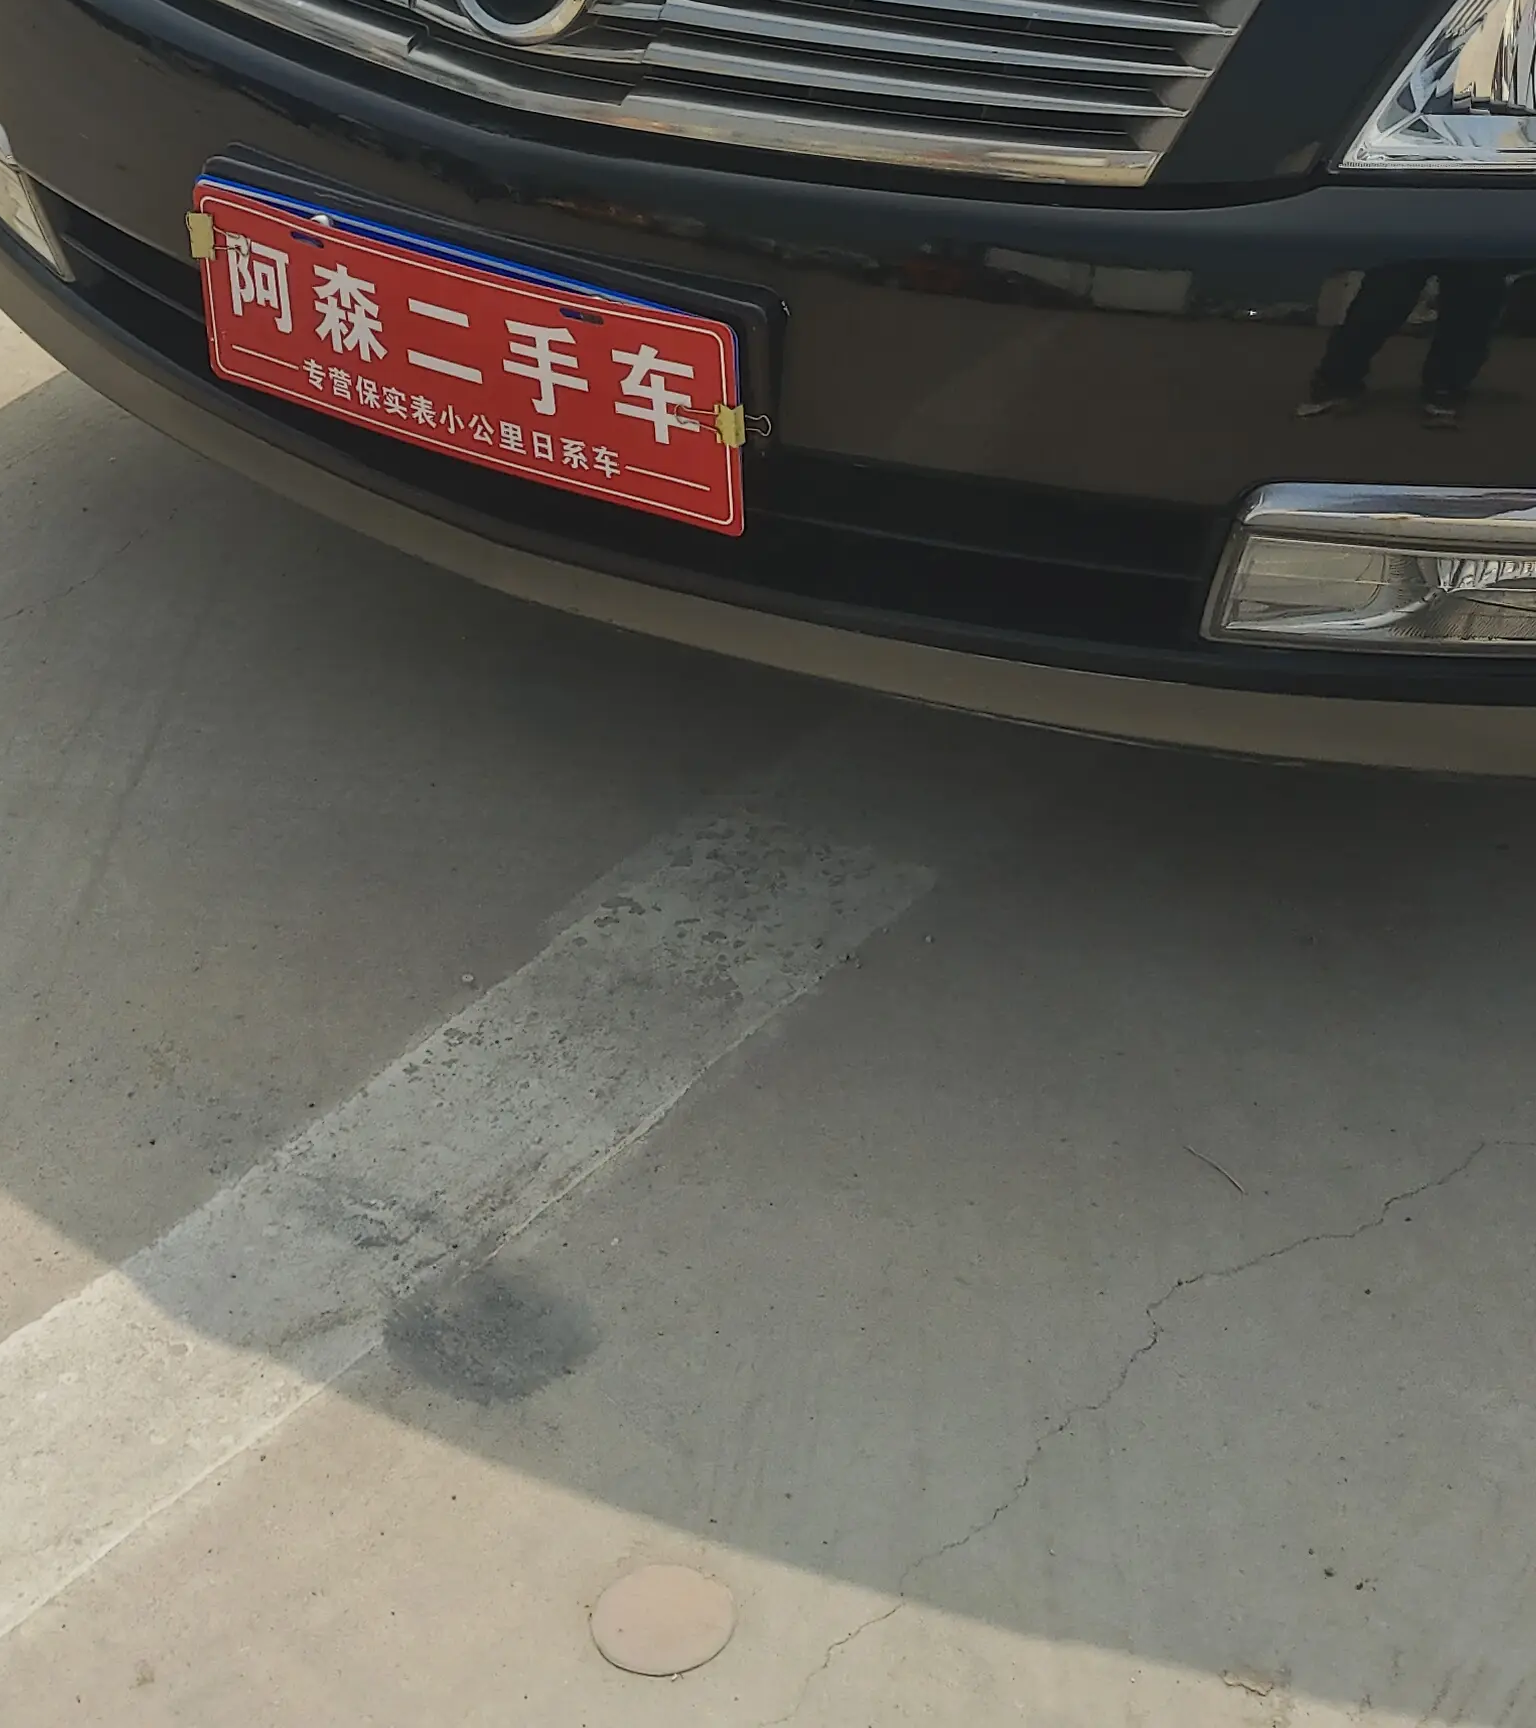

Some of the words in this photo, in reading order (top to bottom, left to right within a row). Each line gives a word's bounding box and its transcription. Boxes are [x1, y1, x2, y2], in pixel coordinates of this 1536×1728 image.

[227, 233, 701, 445] 阿森二手车
[302, 359, 621, 479] 专营保实表小公里日系车
